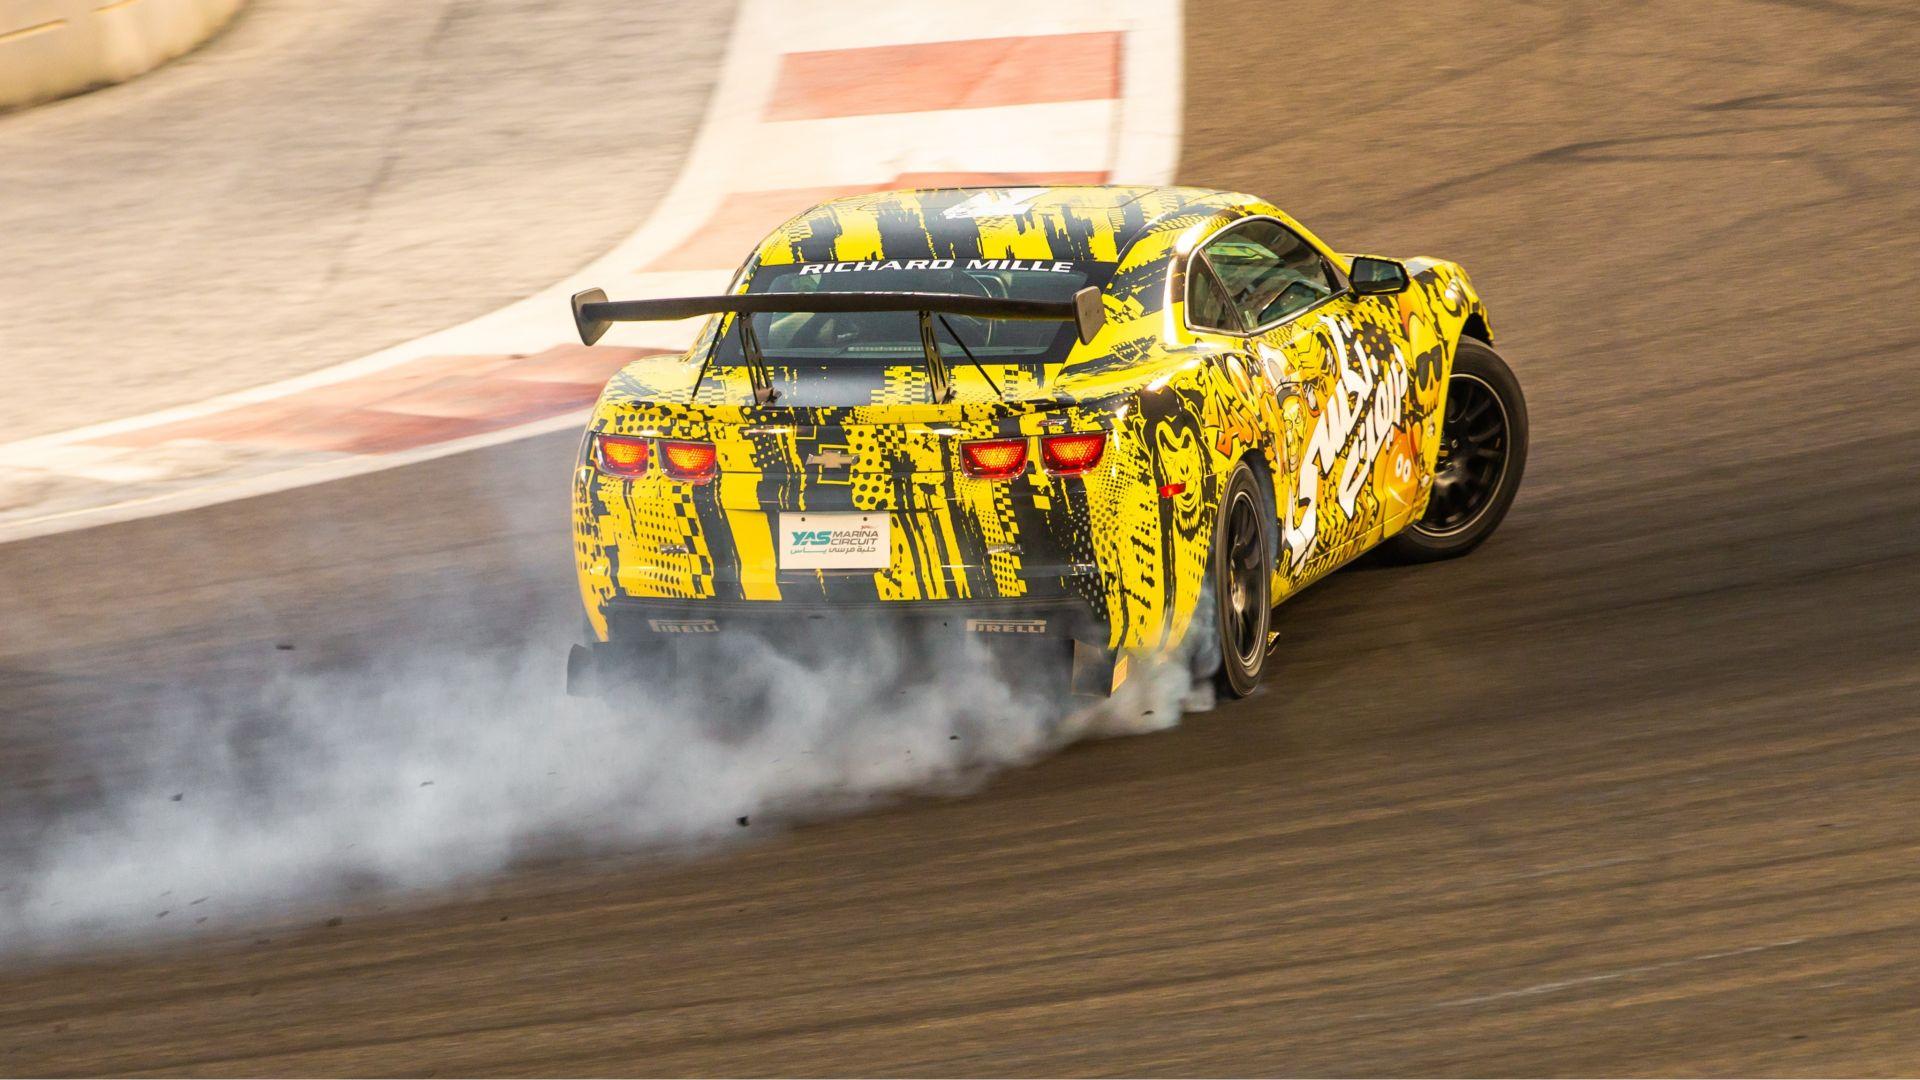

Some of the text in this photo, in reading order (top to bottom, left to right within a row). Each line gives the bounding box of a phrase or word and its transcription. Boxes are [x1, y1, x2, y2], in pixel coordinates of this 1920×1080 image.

[799, 259, 1073, 275] RICHARD MILLE
[791, 530, 879, 546] YAS MARINA
[830, 538, 878, 546] CIRCUIT
[648, 619, 720, 633] PIRELLI
[966, 619, 1047, 633] PIRELLI
